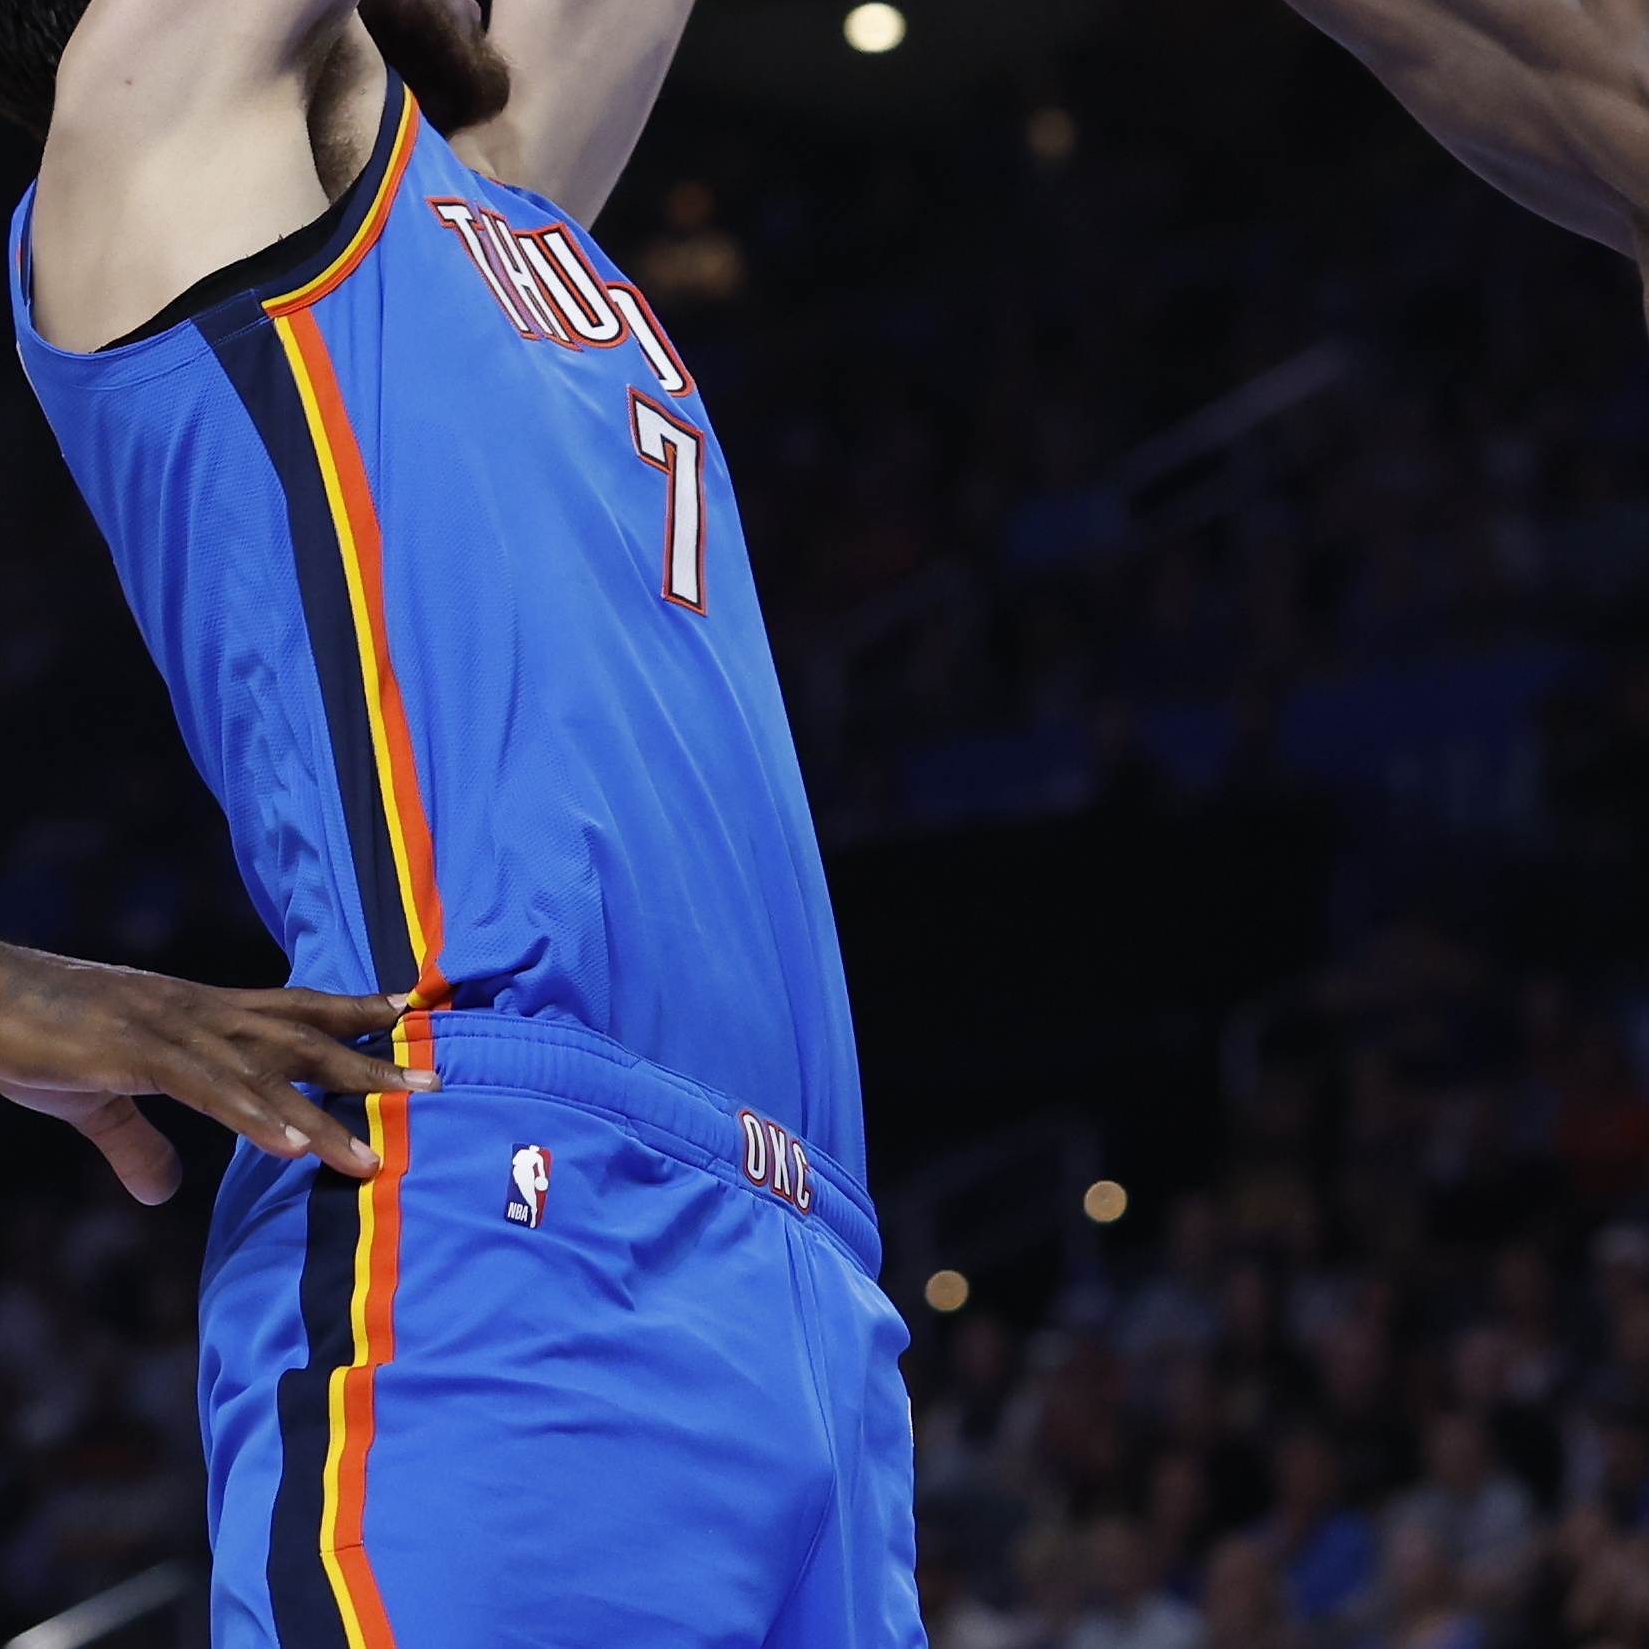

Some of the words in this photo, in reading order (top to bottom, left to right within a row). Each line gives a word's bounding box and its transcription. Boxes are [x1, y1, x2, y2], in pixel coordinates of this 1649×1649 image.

[627, 384, 707, 616] 7
[507, 1201, 529, 1222] NBA
[739, 1110, 813, 1213] OKC
